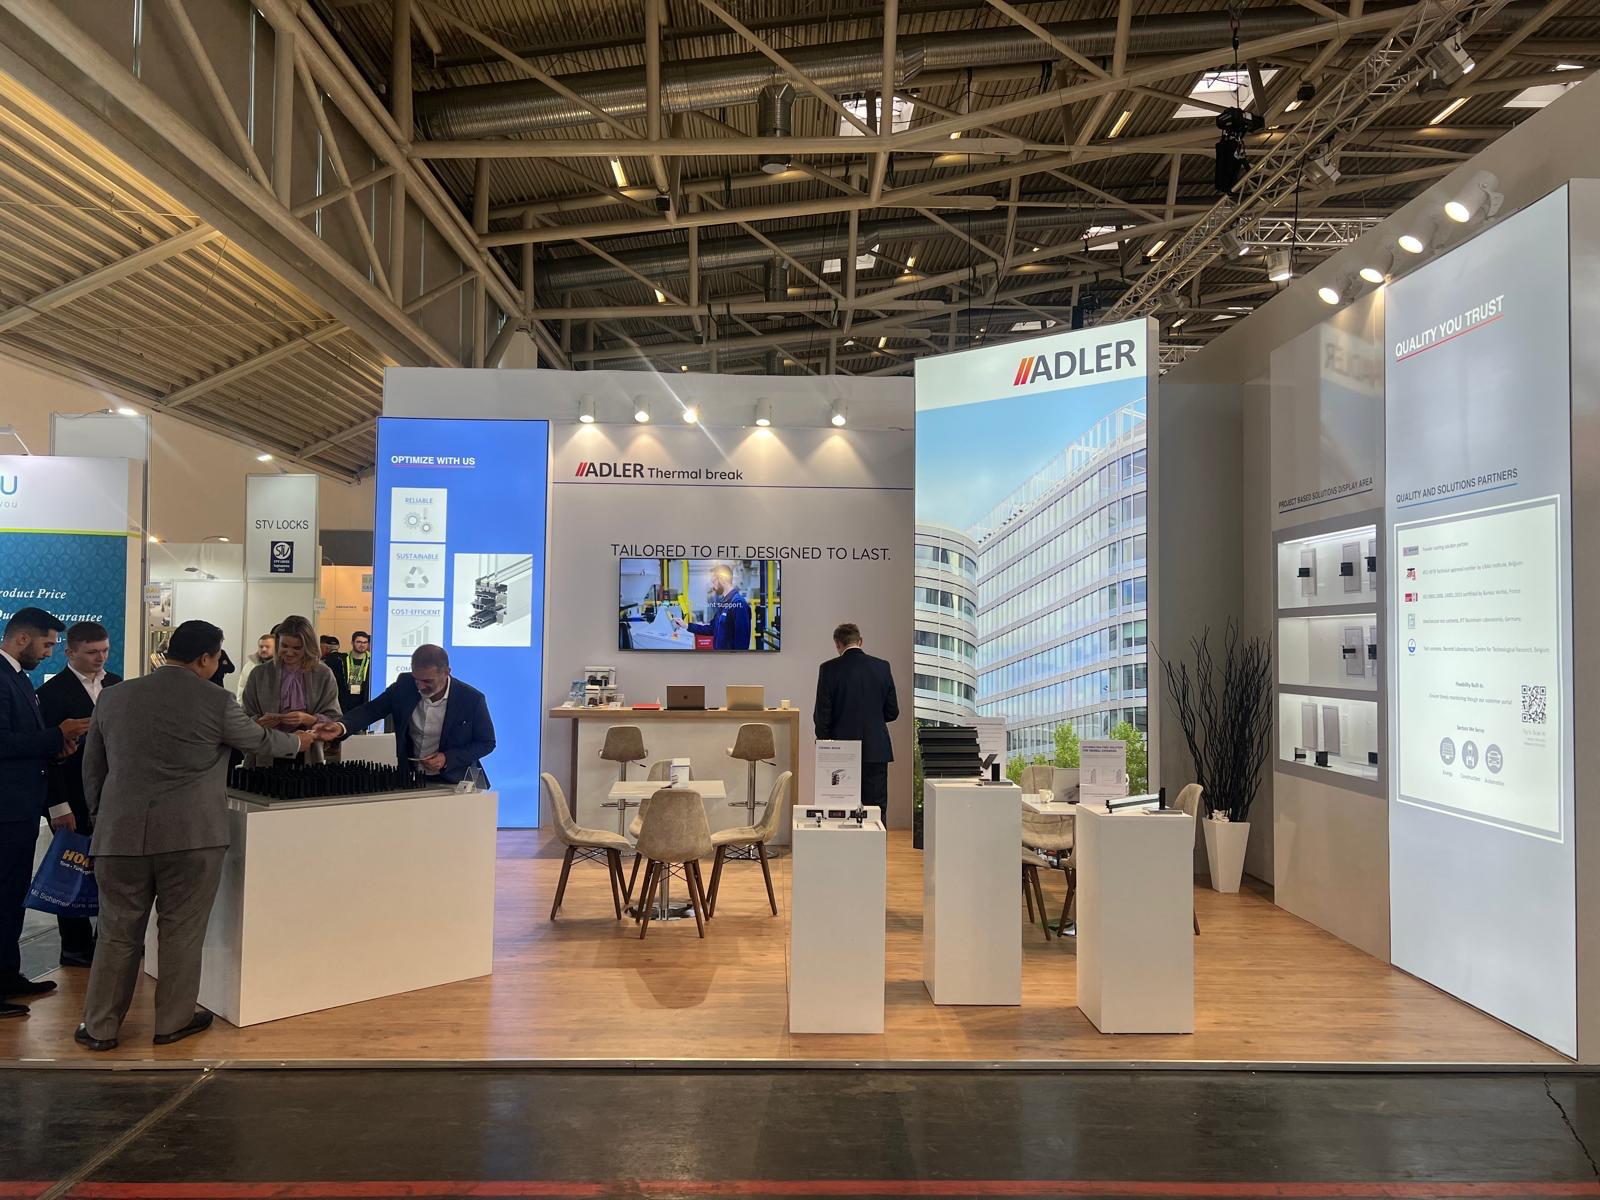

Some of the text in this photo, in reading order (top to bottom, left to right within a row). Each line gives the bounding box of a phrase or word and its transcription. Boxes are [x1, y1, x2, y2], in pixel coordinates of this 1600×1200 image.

[1395, 294, 1505, 357] QUALITY YOU TRUST
[1029, 339, 1137, 384] ADLER
[391, 455, 476, 465] OPTIMIZE WITH US
[585, 462, 744, 481] ADLER Thermal break
[1278, 477, 1373, 509] PROJECT BASED SOLUTIONS DISPLAY AREA
[1396, 468, 1518, 503] QUALITY AND SOLUTIONS PARTNERS
[255, 519, 309, 530] STV LOCKS
[396, 552, 439, 560] SUSTAINABLE
[611, 544, 892, 562] TAILORED TO FIT. DESIGNED TO LAST.
[0, 587, 68, 599] roduct Price
[46, 610, 103, 622] uarantee
[391, 608, 441, 616] COST-EFFICIENT
